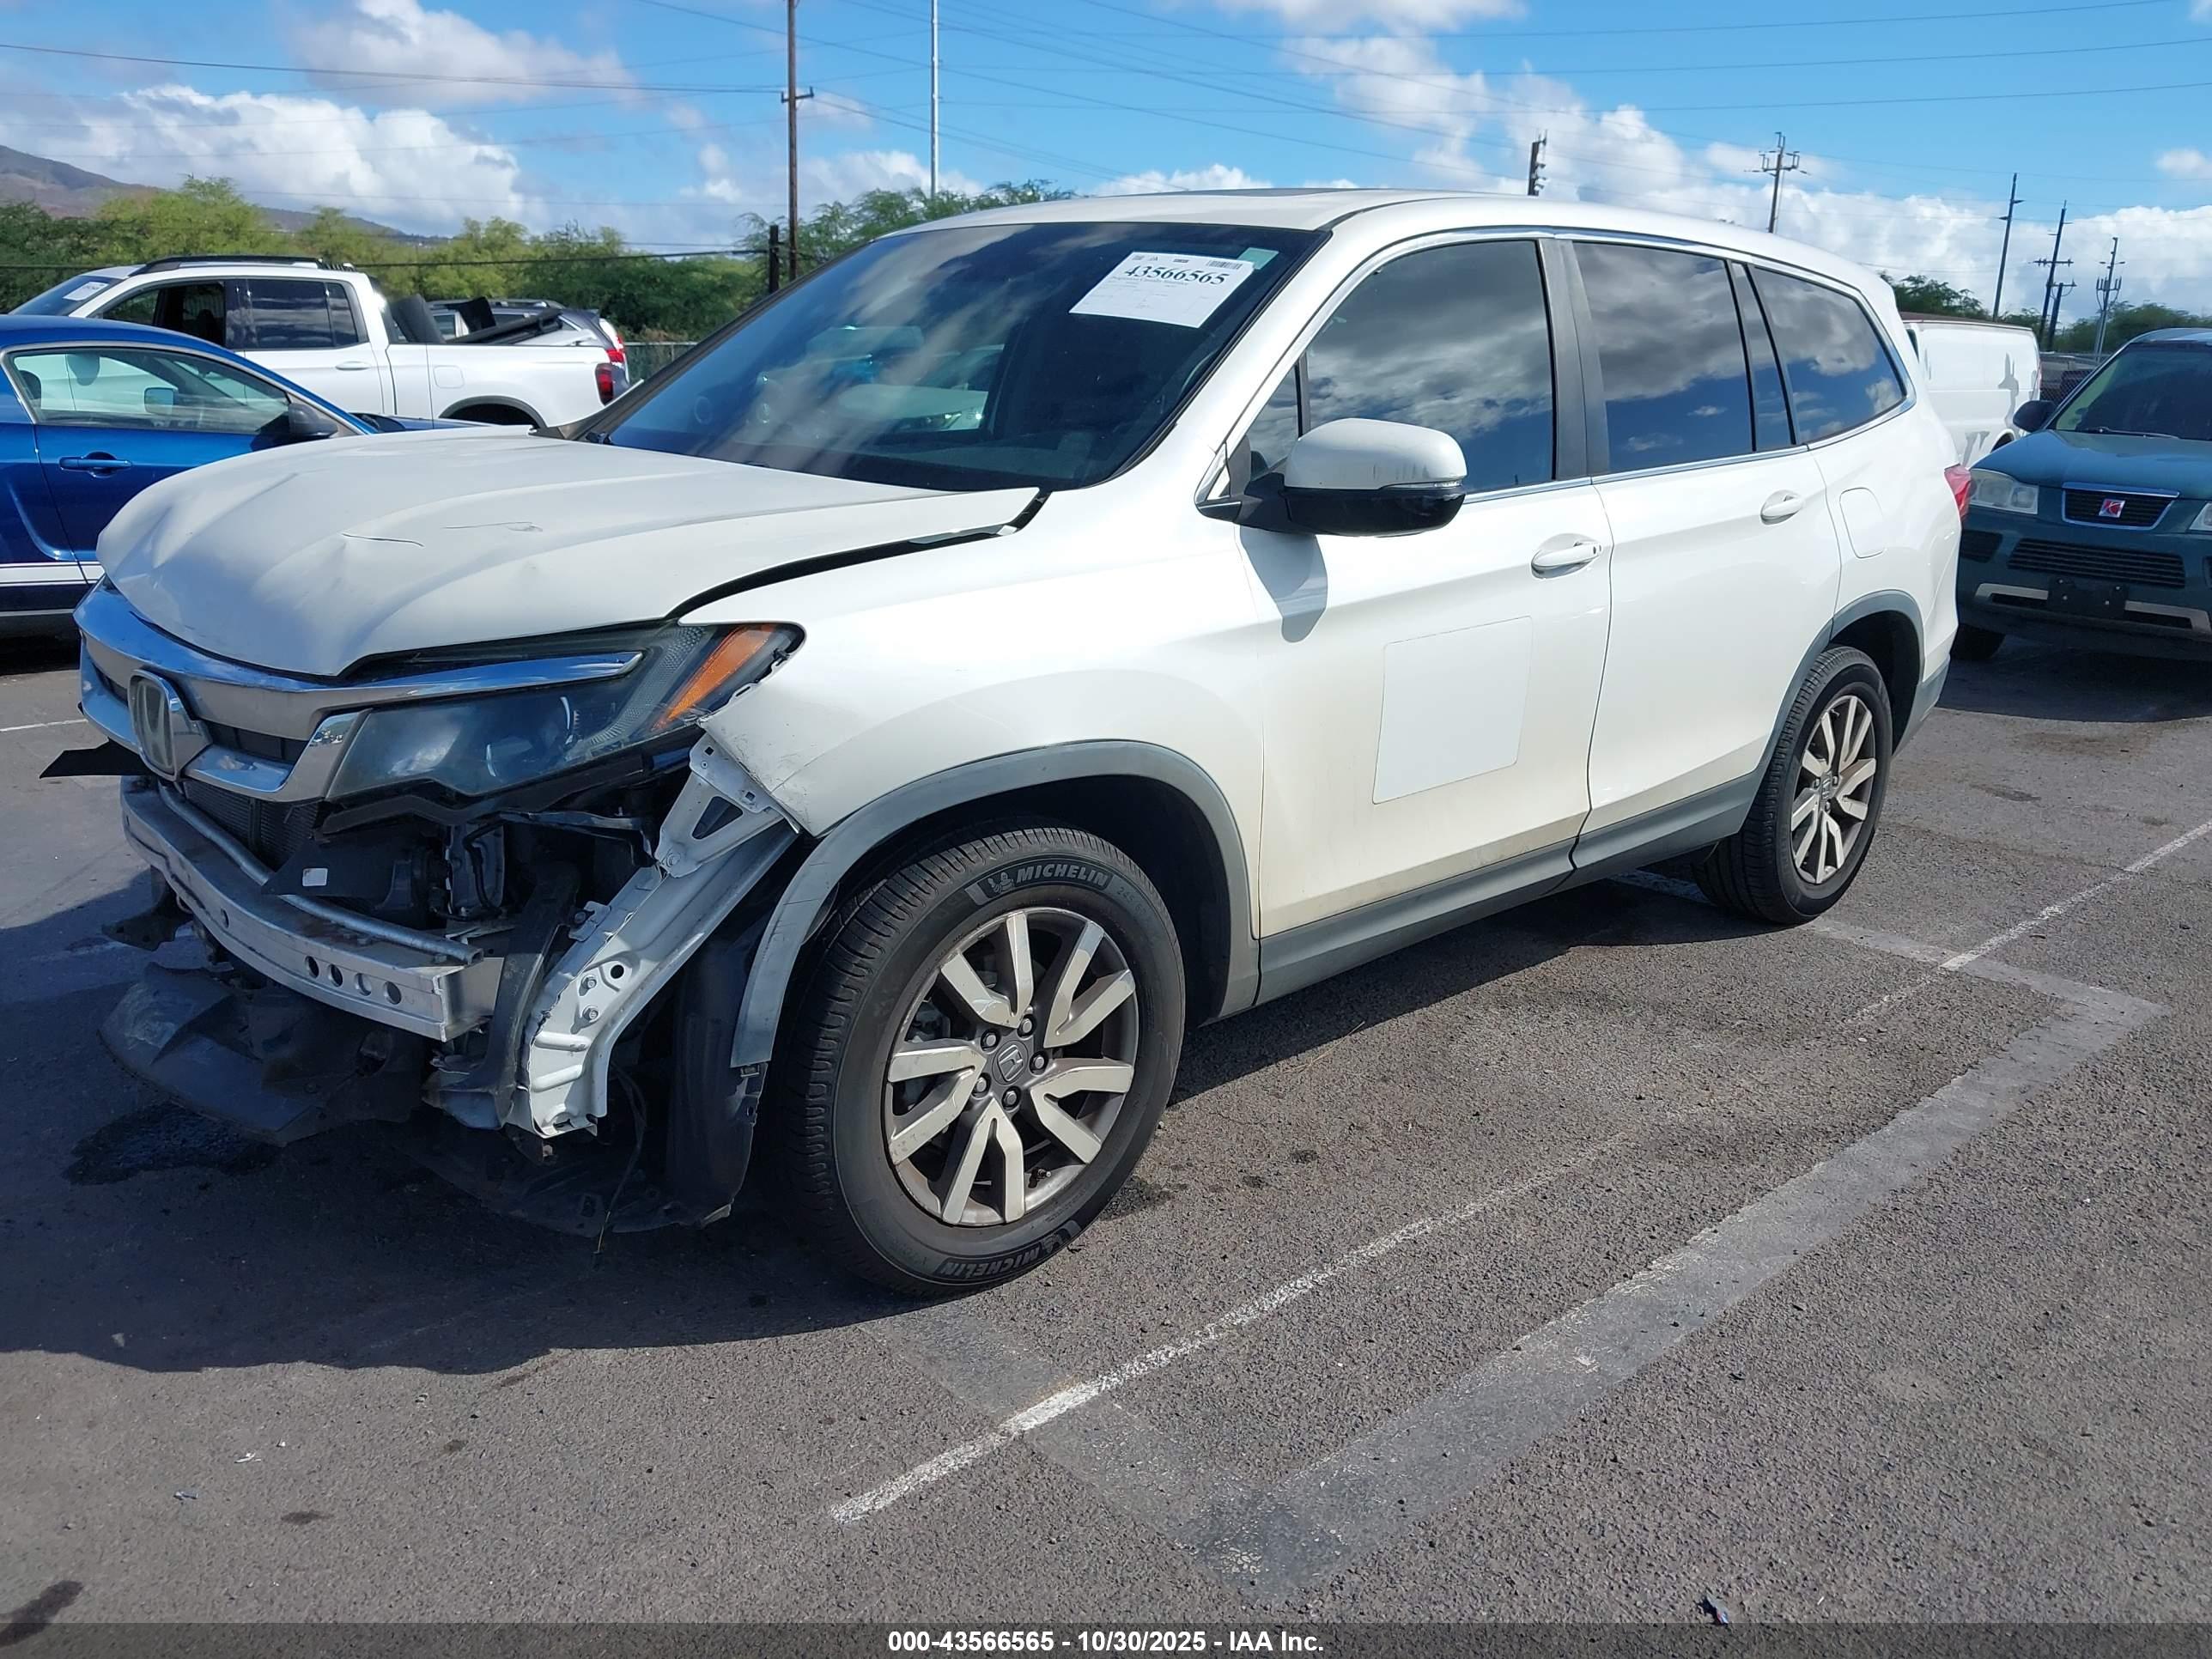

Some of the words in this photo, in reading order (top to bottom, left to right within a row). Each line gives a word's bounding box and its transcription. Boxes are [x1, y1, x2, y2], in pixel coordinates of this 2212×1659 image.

[1124, 264, 1231, 285] 43566565
[1016, 863, 1109, 887] MICHELIN
[940, 1245, 1042, 1279] MICHELIN
